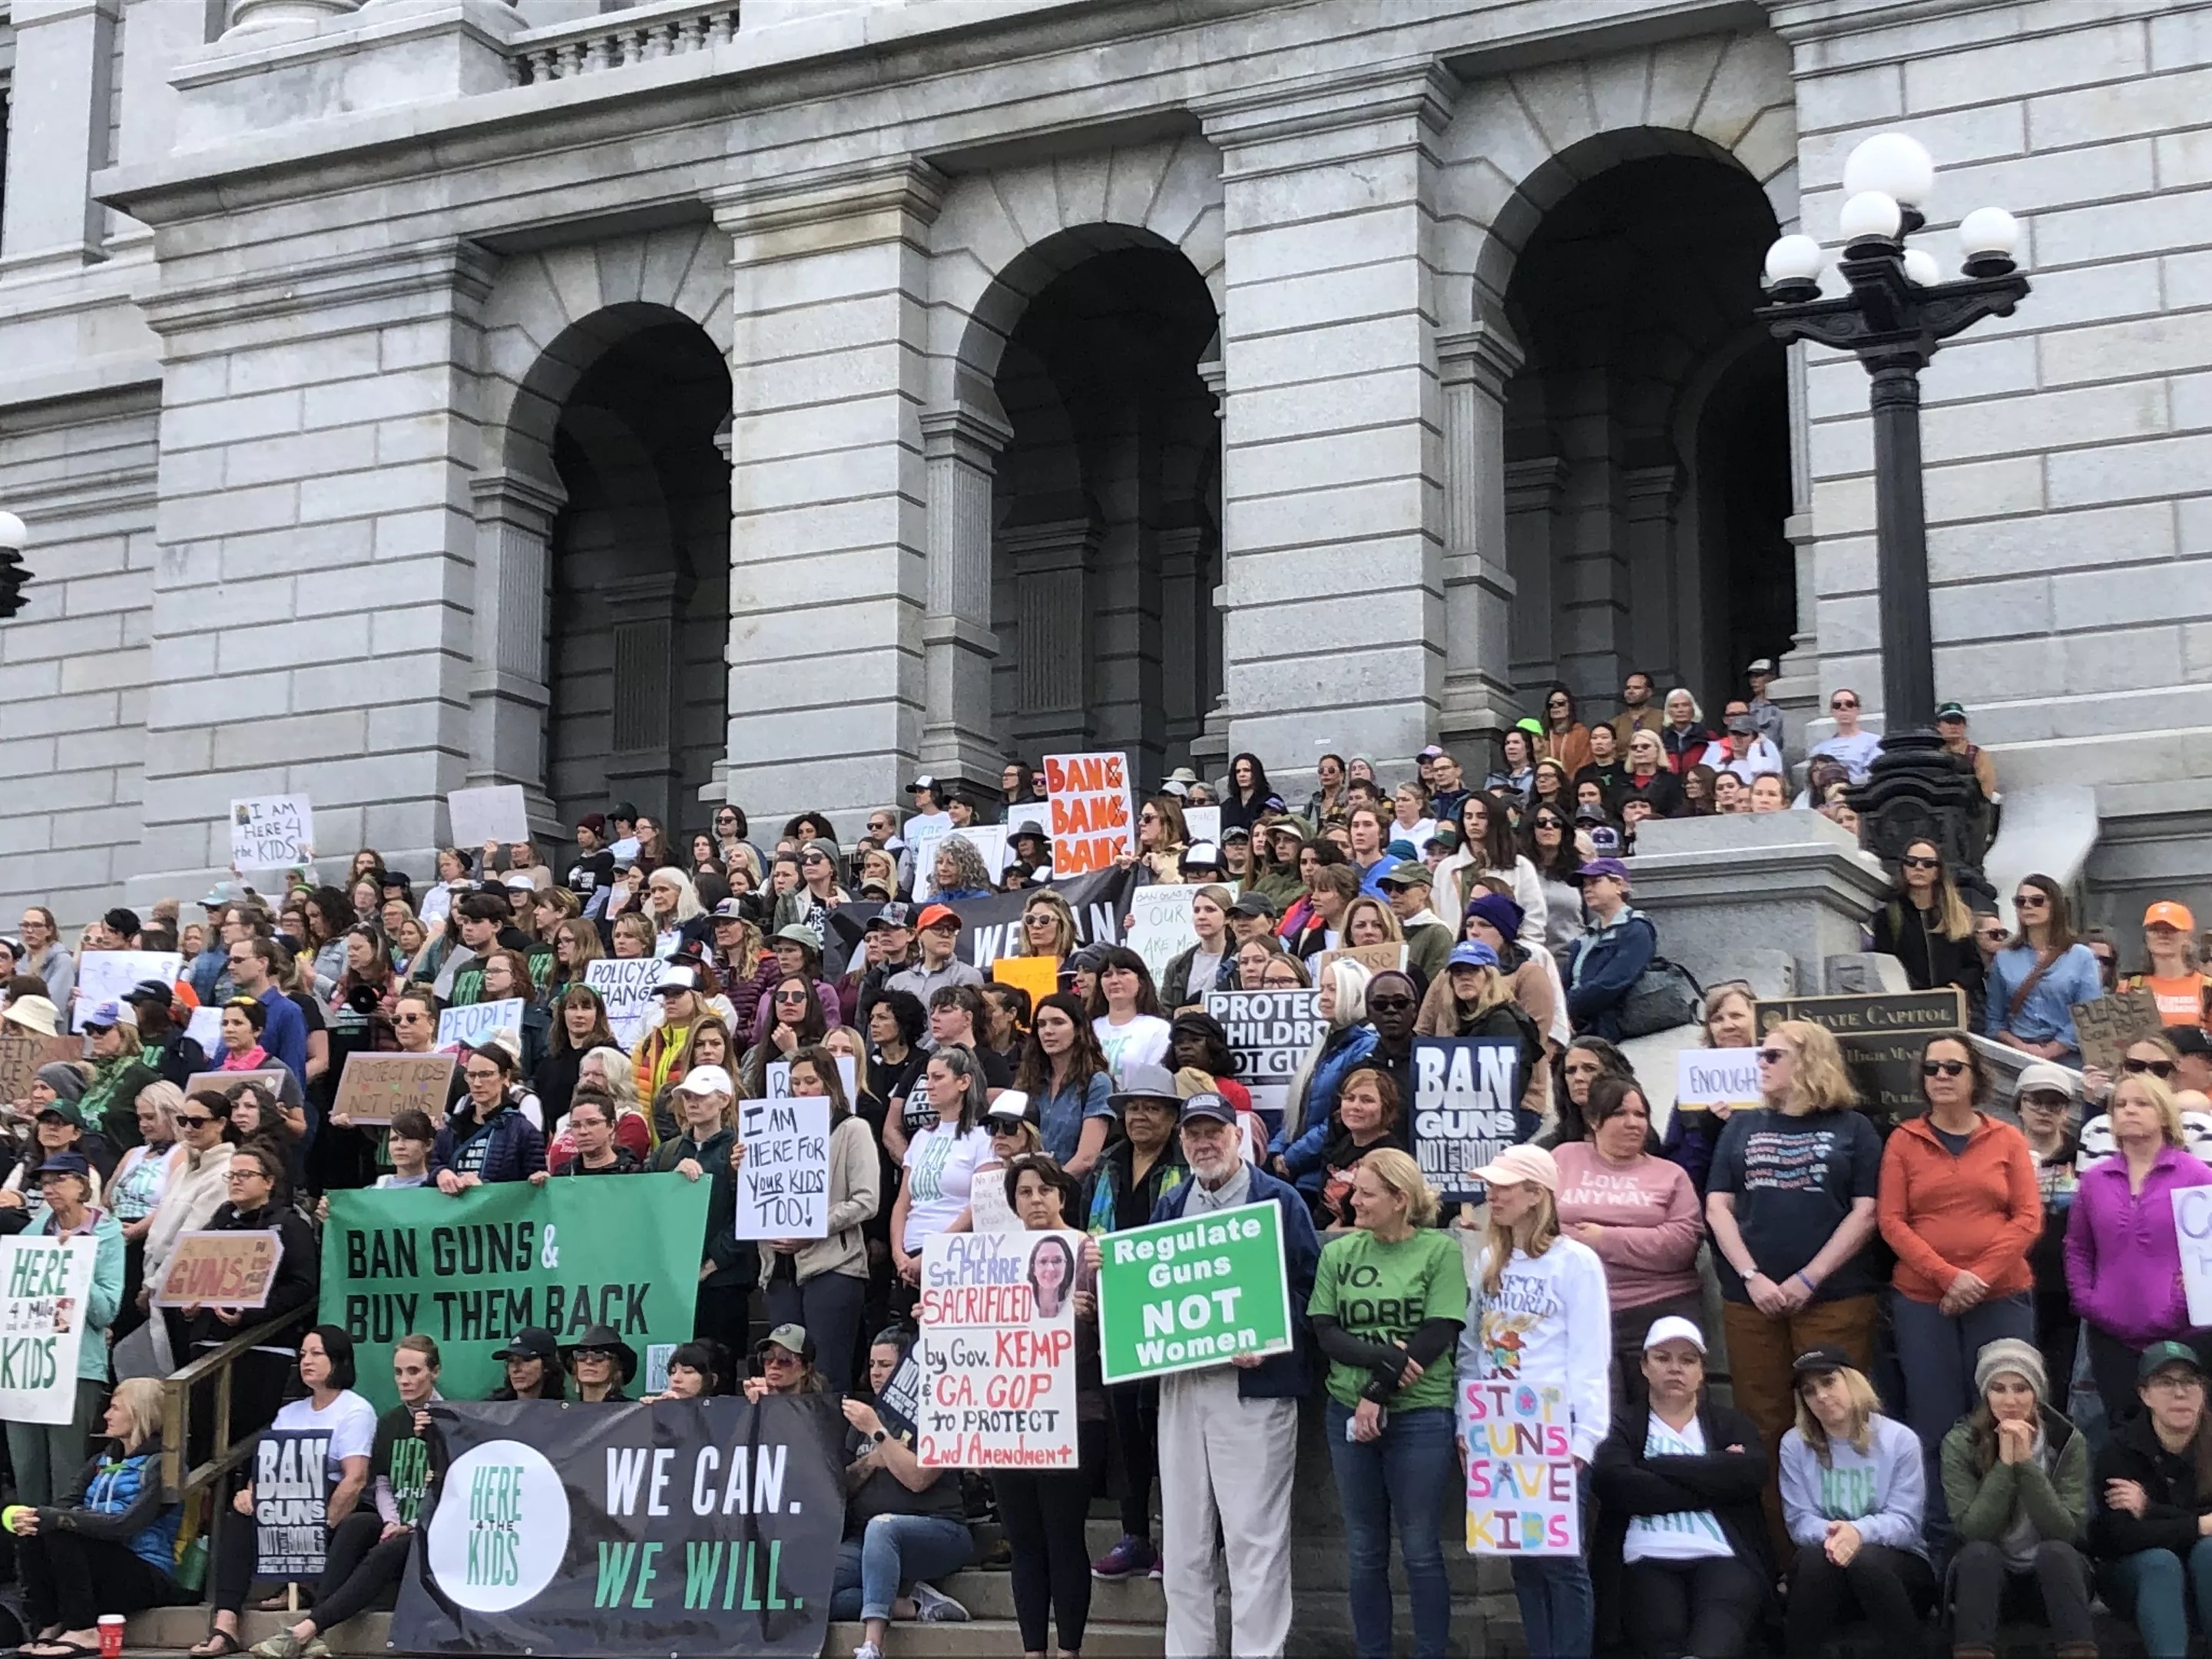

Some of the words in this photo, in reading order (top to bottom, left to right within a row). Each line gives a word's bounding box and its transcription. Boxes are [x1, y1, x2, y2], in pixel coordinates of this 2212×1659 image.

[1045, 757, 1123, 793] BANG
[243, 822, 281, 839] HERE
[285, 817, 302, 837] 4
[250, 803, 263, 820] I
[272, 803, 297, 816] AM
[1051, 795, 1128, 835] BANG
[233, 845, 253, 859] the
[257, 835, 297, 861] KIDS
[1150, 905, 1186, 926] OUR
[973, 920, 1022, 968] WE
[600, 984, 655, 1007] HANGE
[1210, 993, 1323, 1022] PROTEC
[1798, 1008, 1862, 1028] STATE
[1866, 1005, 1952, 1025] CAPITOL
[346, 1061, 410, 1084] PROTECT
[412, 1063, 446, 1082] KIDS
[1269, 1050, 1310, 1072] GU
[1415, 1046, 1517, 1110] BAN
[1689, 1065, 1757, 1094] ENOUGH
[349, 1093, 382, 1113] NOT
[390, 1092, 435, 1115] GUNS
[743, 1106, 764, 1137] I
[769, 1107, 798, 1134] AM
[1416, 1111, 1517, 1138] GUNS
[749, 1139, 793, 1168] HERE
[798, 1136, 826, 1162] FOR
[1416, 1139, 1447, 1172] NOT
[747, 1171, 784, 1201] YOUR
[789, 1168, 826, 1194] KIDS
[1581, 1170, 1639, 1190] LOVE
[754, 1196, 813, 1228] TOO!
[1560, 1187, 1651, 1207] ANYWAY
[346, 1228, 419, 1279] BAN
[432, 1221, 534, 1277] GUNS
[541, 1224, 559, 1269] &
[946, 1233, 1006, 1262] AMY
[1114, 1217, 1261, 1265] Regulate
[8, 1248, 74, 1297] HERE
[166, 1257, 243, 1296] GUNS
[959, 1257, 1022, 1285] PIERRE
[1148, 1256, 1232, 1289] Guns
[347, 1293, 419, 1343] BUY
[433, 1286, 533, 1341] THEM
[545, 1283, 651, 1336] BACK
[923, 1285, 1032, 1325] SACRIFICED
[1142, 1286, 1243, 1338] NOT
[1, 1336, 57, 1389] KIDS
[924, 1338, 947, 1375] by
[951, 1338, 990, 1367] Gov.
[995, 1330, 1072, 1368] KEMP
[1135, 1327, 1257, 1367] Women
[936, 1374, 979, 1407] GA.
[986, 1373, 1052, 1409] GOP
[1466, 1383, 1561, 1422] STOP
[928, 1410, 956, 1432] to
[963, 1409, 1060, 1433] PROTECT
[1469, 1422, 1568, 1456] GUNS
[256, 1439, 328, 1498] BAN
[607, 1447, 676, 1516] WE
[692, 1444, 801, 1516] CAN.
[1467, 1460, 1571, 1502] SAVE
[469, 1466, 525, 1522] HERE
[1820, 1466, 1876, 1519] HERE
[257, 1500, 326, 1525] GUNS
[476, 1520, 483, 1531] 4
[488, 1520, 514, 1532] THE
[257, 1526, 279, 1555] NOT
[1466, 1510, 1570, 1550] KIDS
[467, 1530, 519, 1587] KIDS
[594, 1541, 663, 1608] WE
[684, 1539, 803, 1611] WILL.
